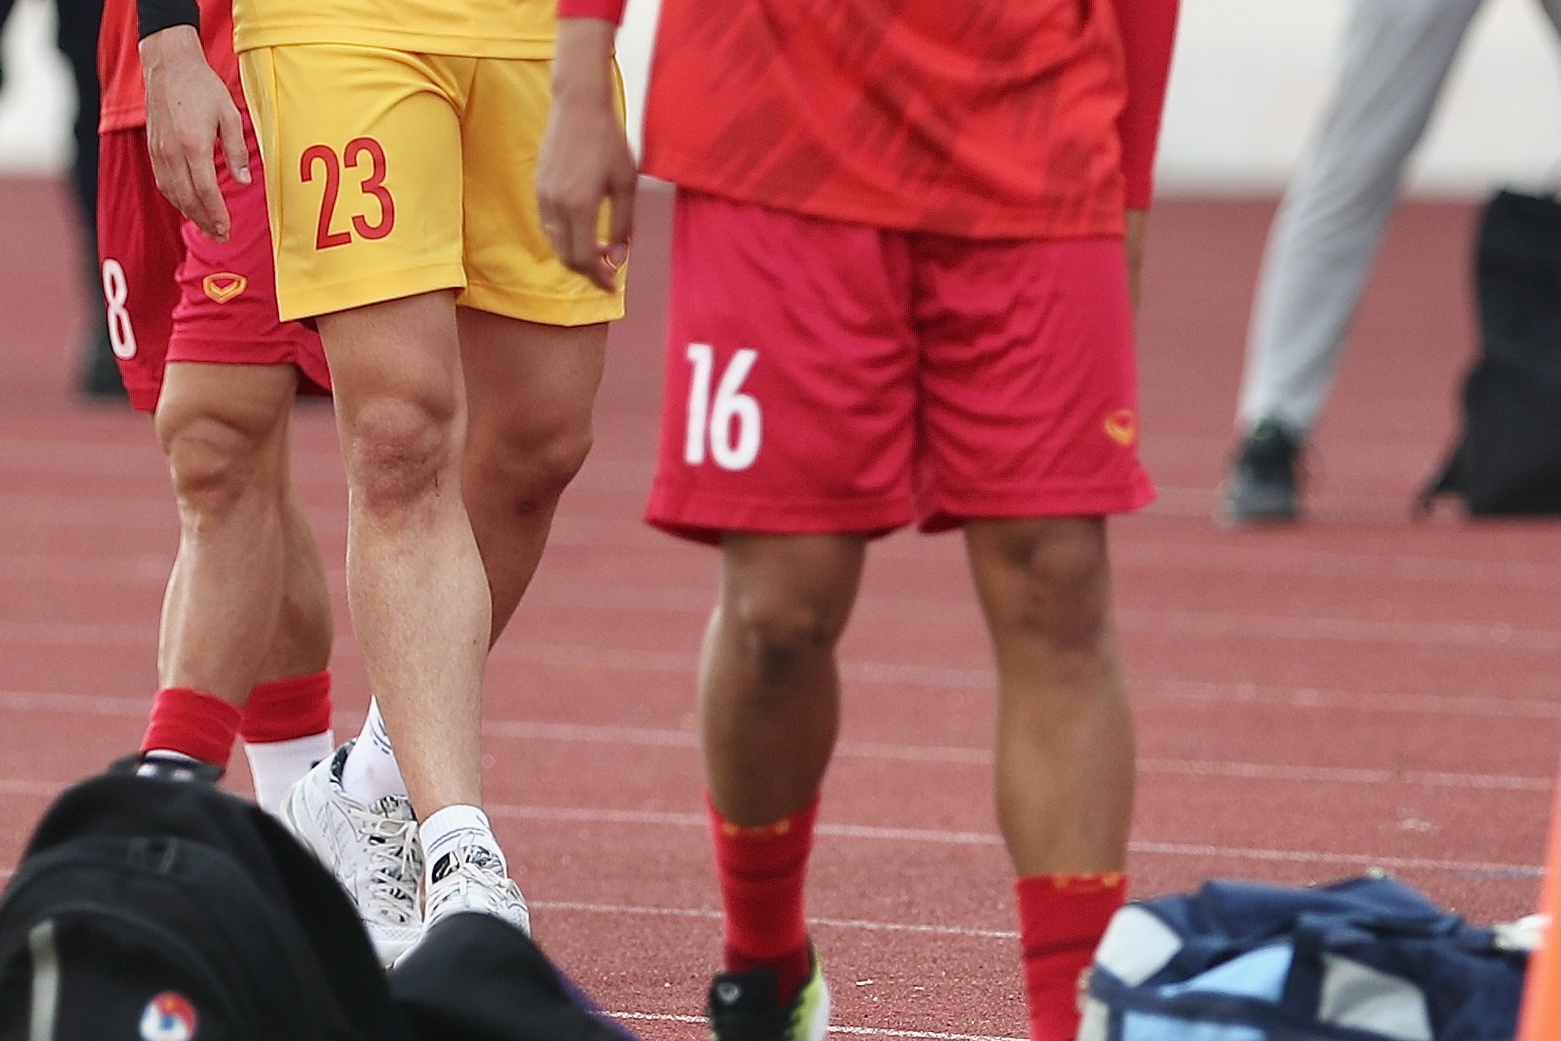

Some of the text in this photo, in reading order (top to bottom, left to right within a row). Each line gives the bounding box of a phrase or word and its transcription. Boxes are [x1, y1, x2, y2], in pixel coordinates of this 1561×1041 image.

[299, 136, 396, 250] 23
[102, 258, 136, 359] 8
[685, 343, 763, 471] 16
